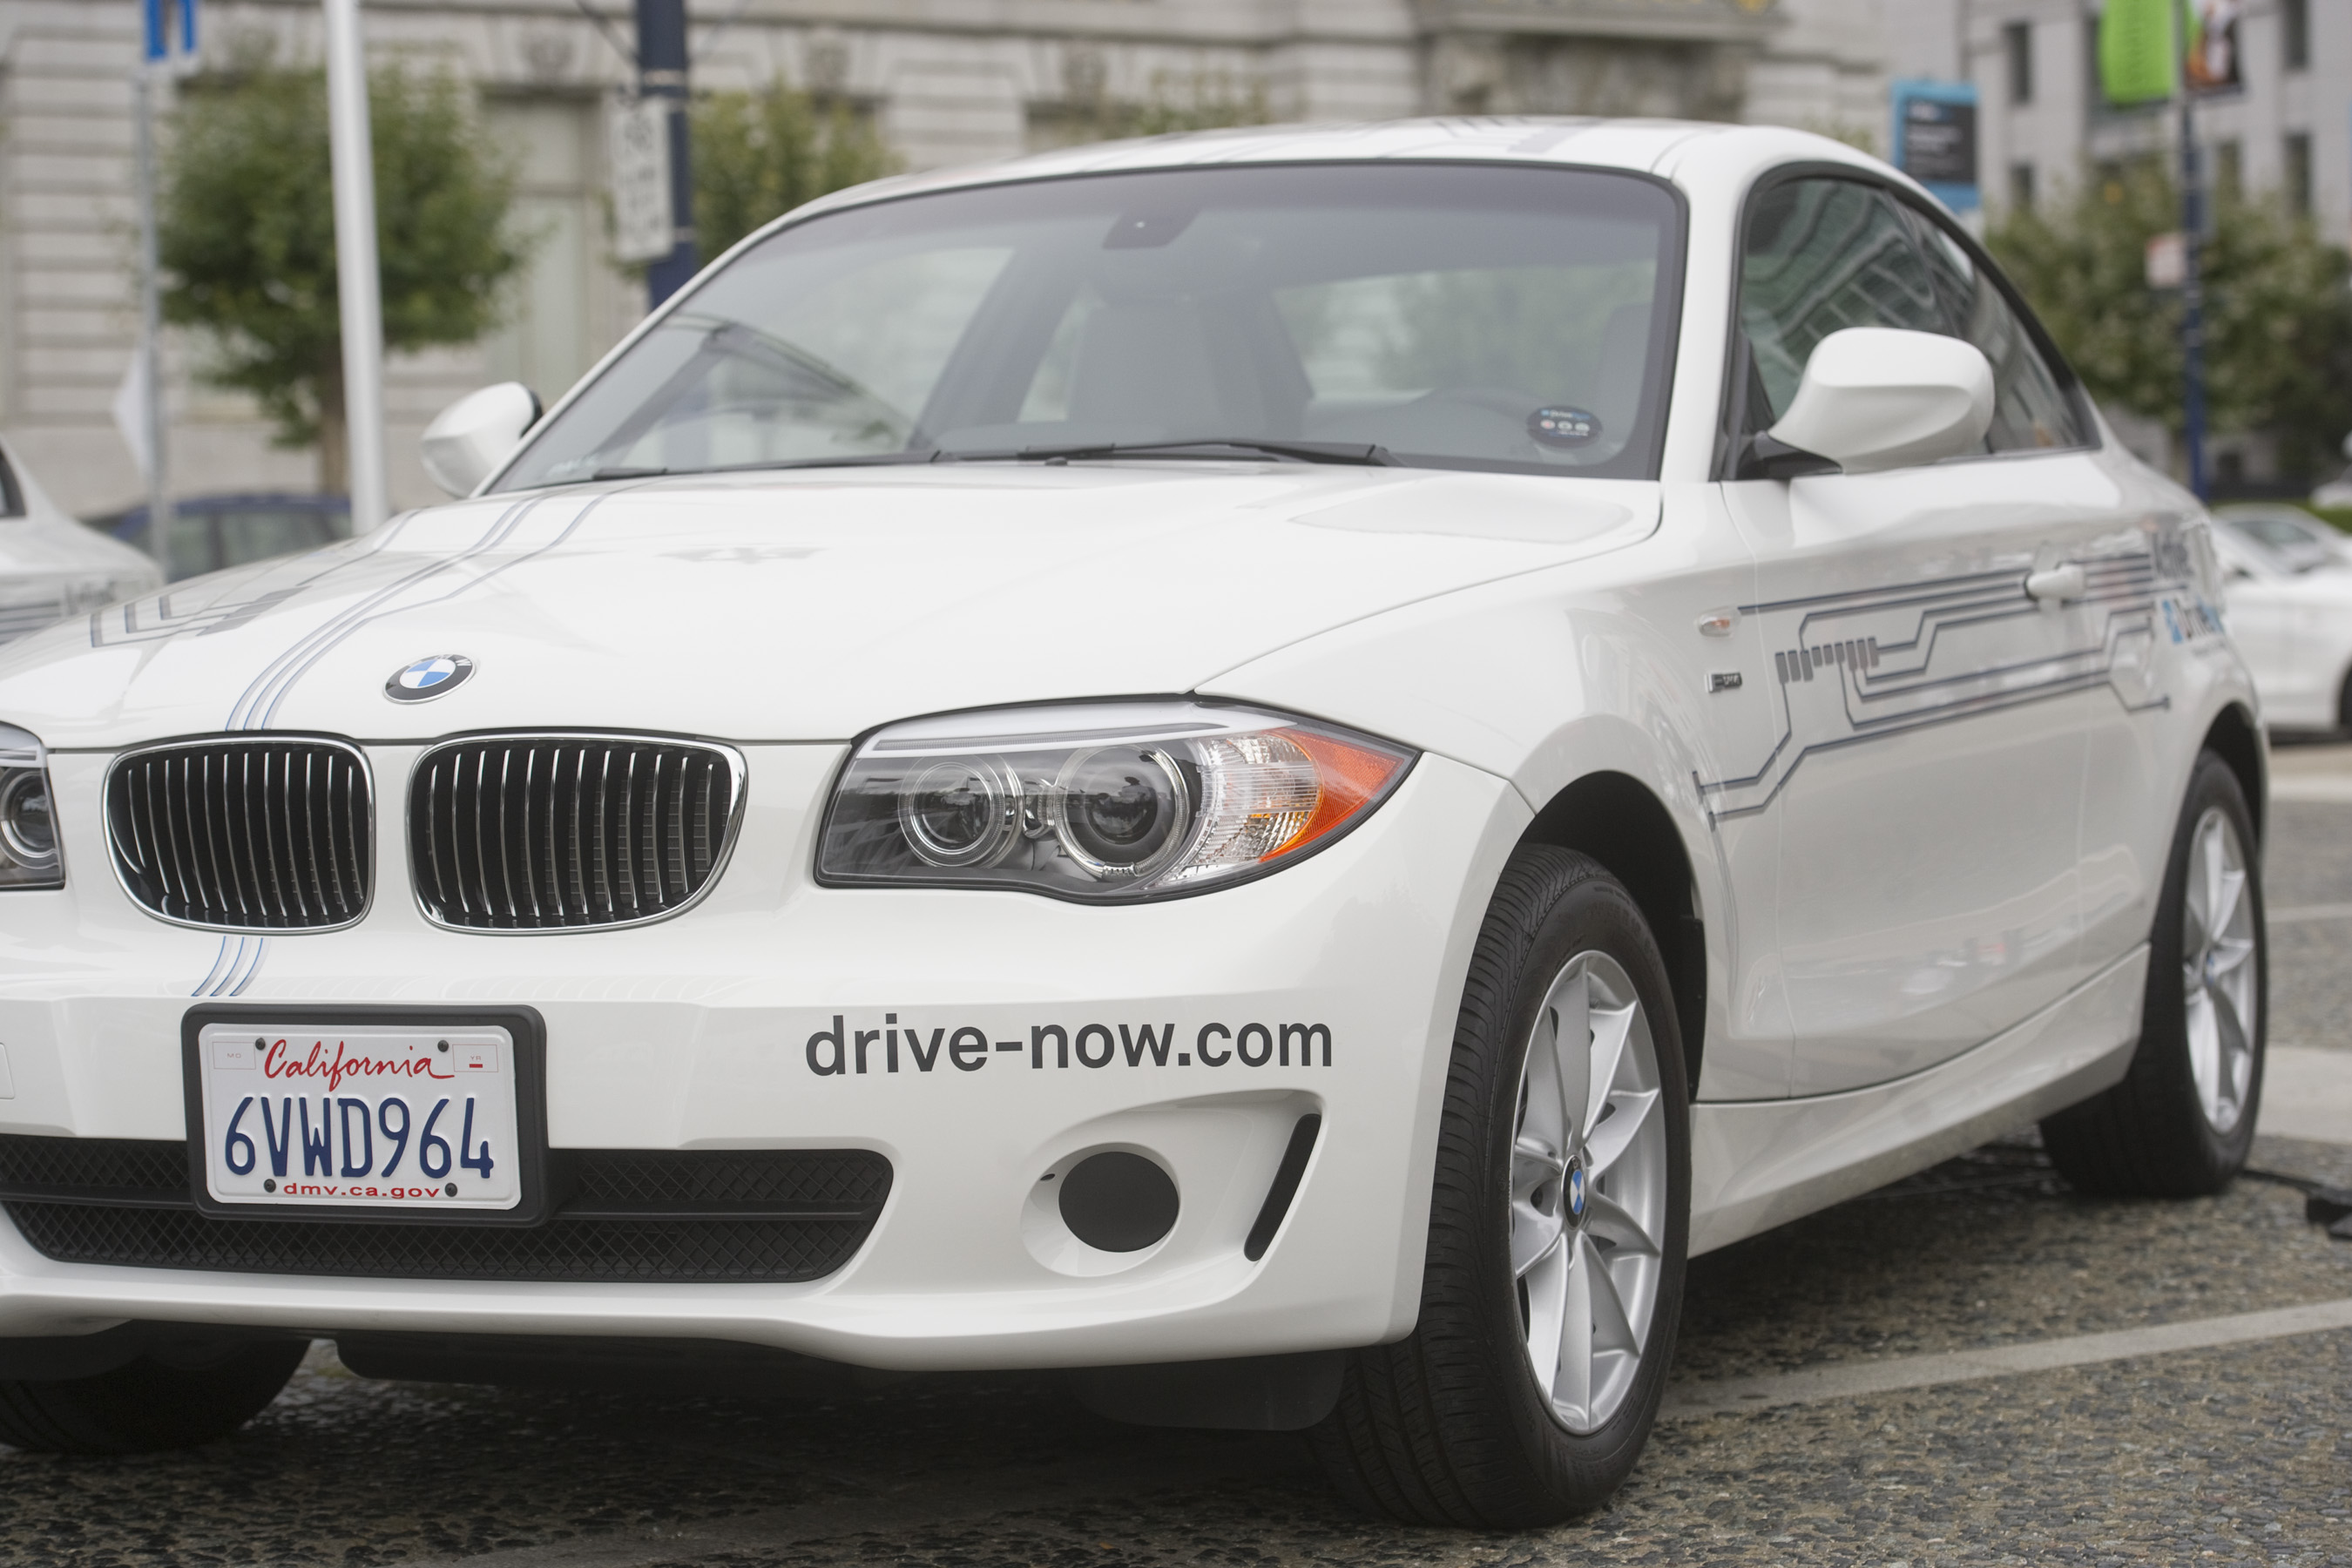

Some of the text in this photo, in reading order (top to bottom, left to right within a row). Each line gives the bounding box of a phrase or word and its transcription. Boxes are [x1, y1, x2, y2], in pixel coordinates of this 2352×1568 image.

[264, 1039, 455, 1092] California
[805, 1012, 1333, 1077] drive-now.com
[225, 1097, 494, 1179] 6VWD964
[283, 1182, 440, 1200] dmv.ca.gov
